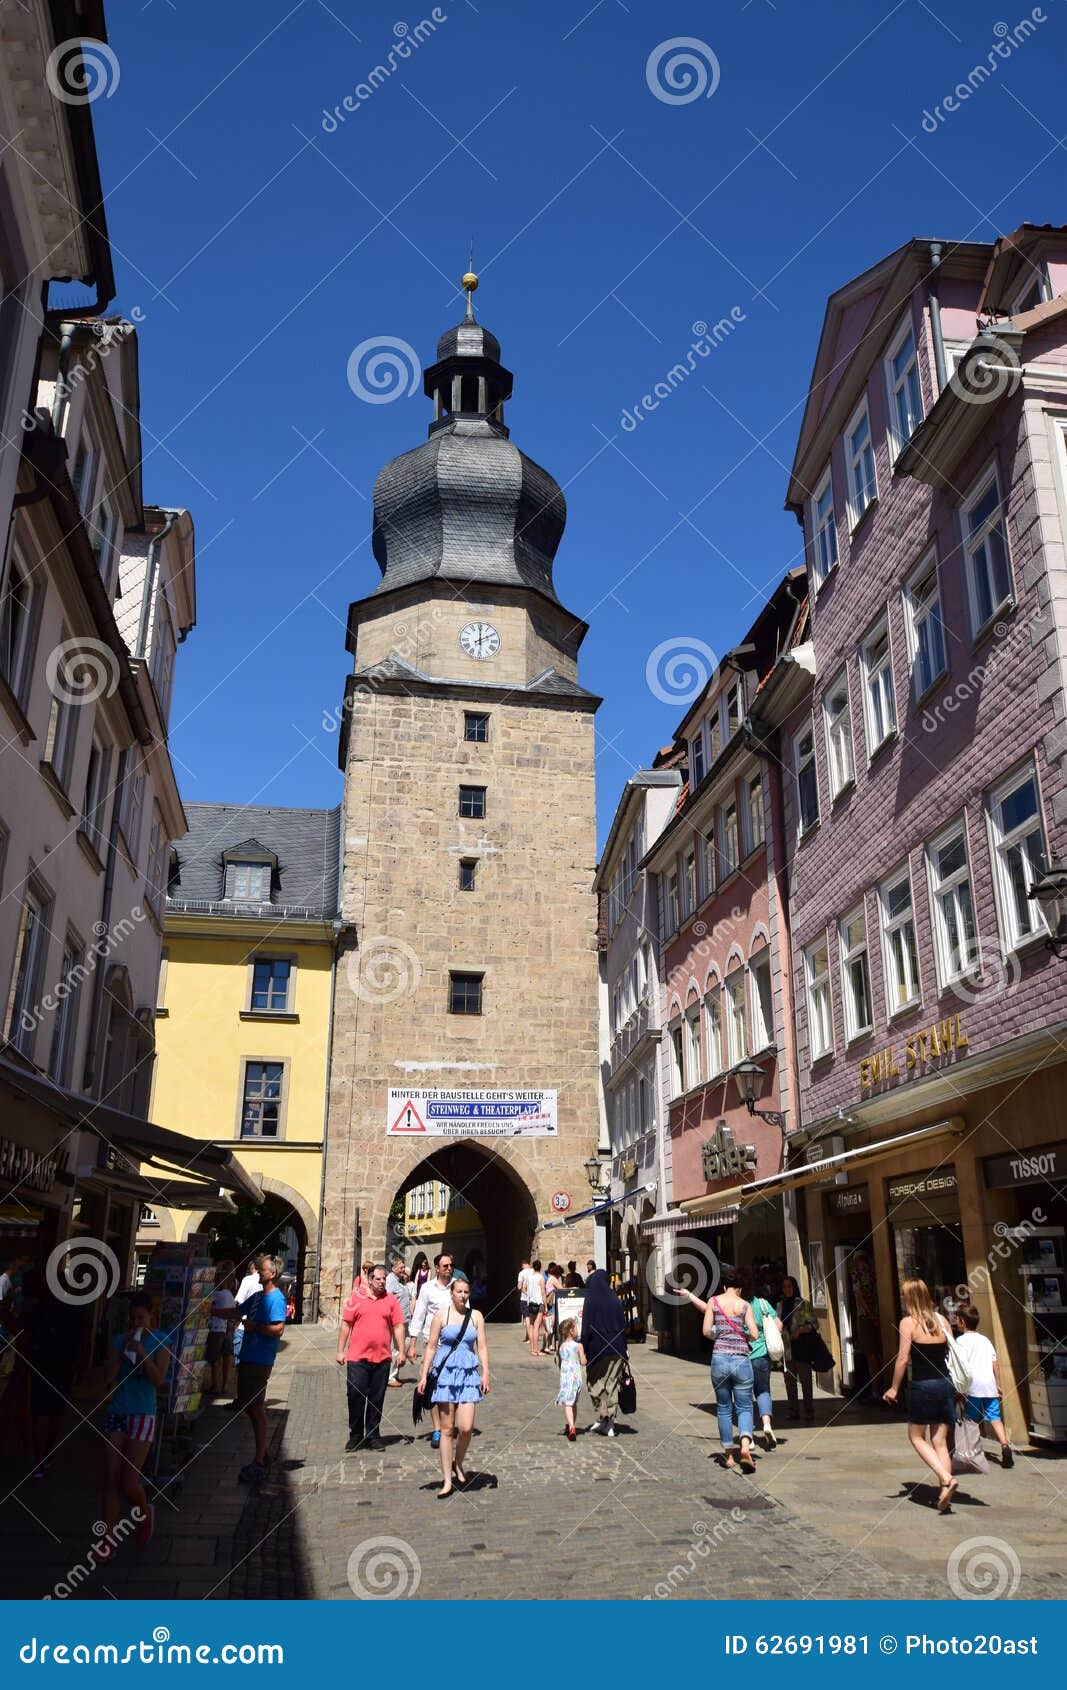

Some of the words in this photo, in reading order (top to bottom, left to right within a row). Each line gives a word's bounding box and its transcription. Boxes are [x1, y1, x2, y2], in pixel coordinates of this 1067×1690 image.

[861, 1046, 900, 1088] EMIL
[906, 1012, 968, 1070] STAHL
[391, 1090, 420, 1099] HINTER
[423, 1090, 438, 1099] DER
[440, 1091, 484, 1100] BAUSTELLE
[486, 1091, 514, 1100] GEHT'S
[430, 1104, 470, 1115] STEINWEG
[473, 1104, 479, 1115] &
[480, 1104, 537, 1116] THEATERPLATZ
[1010, 1152, 1056, 1180] TISSOT
[889, 1182, 926, 1197] PORSCHE
